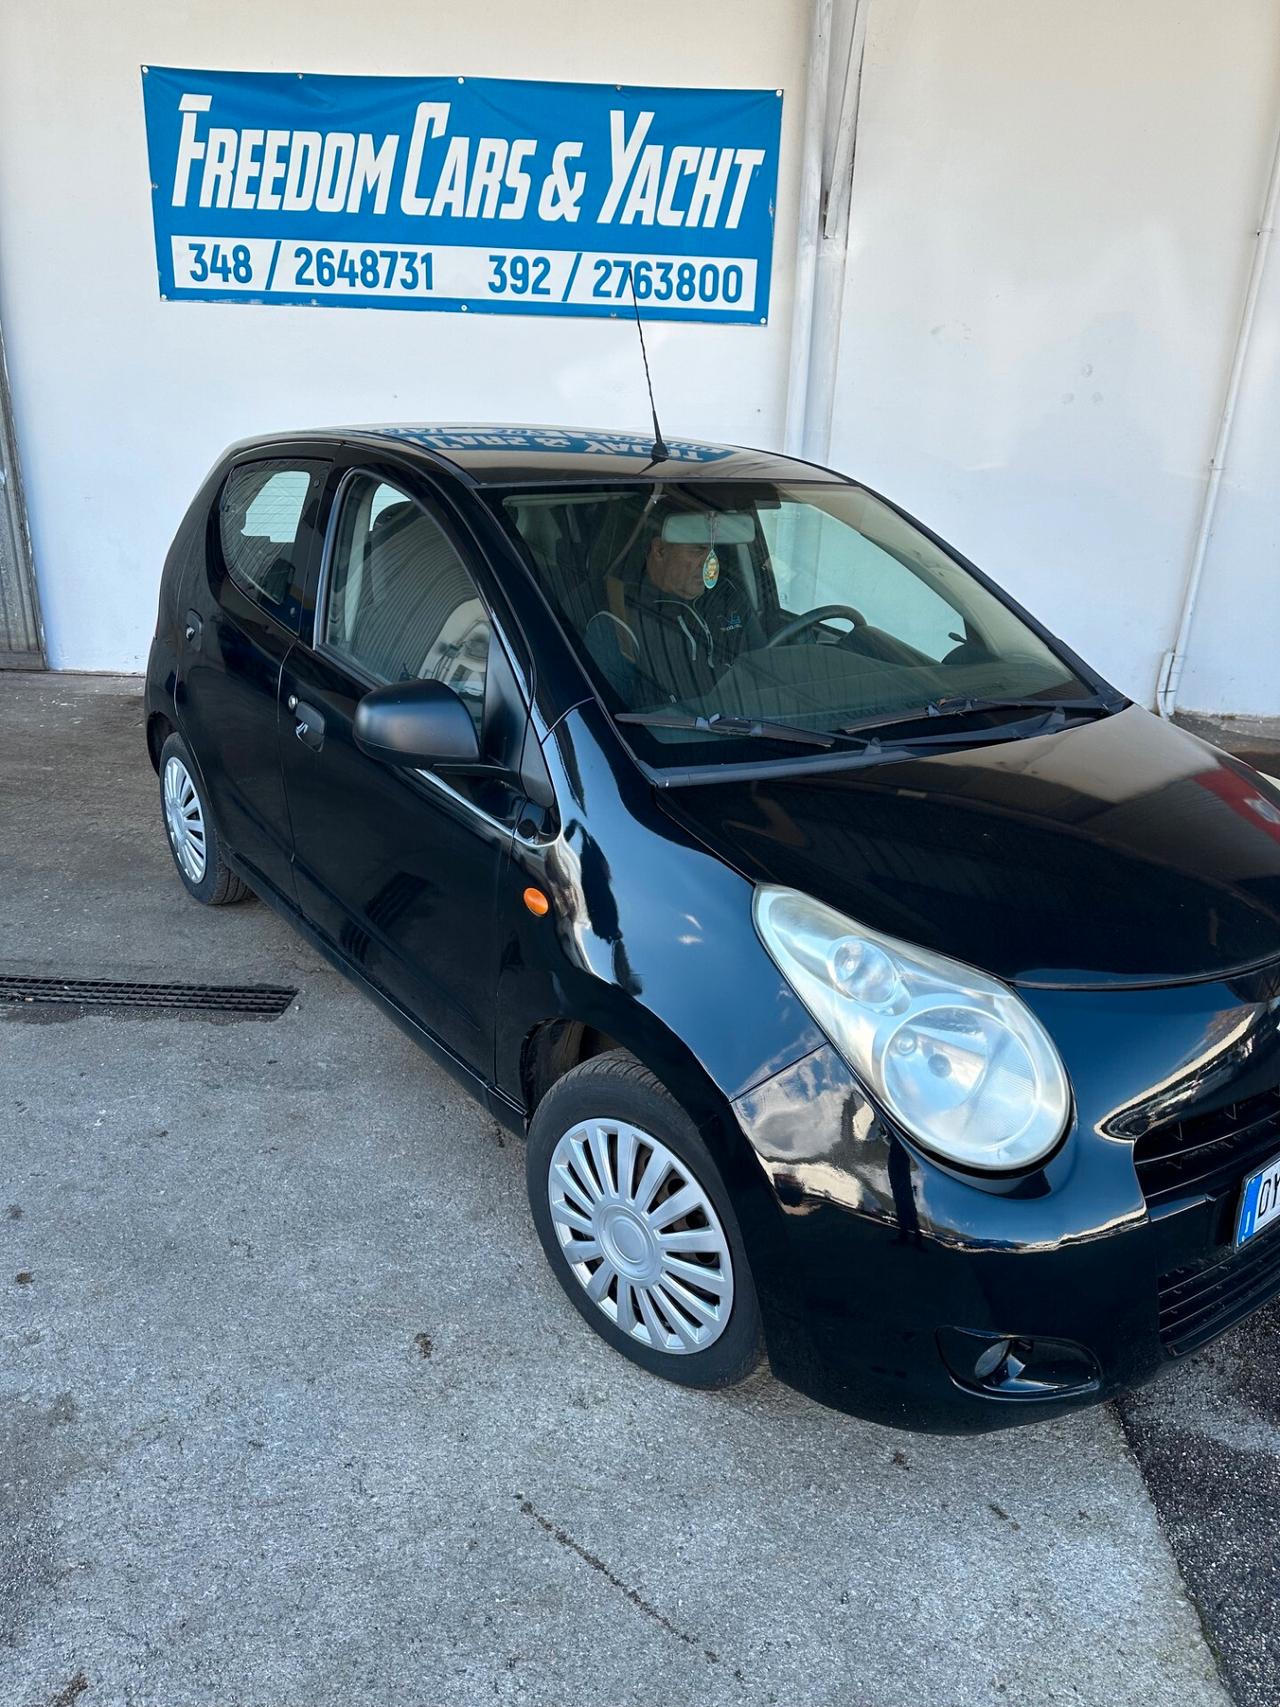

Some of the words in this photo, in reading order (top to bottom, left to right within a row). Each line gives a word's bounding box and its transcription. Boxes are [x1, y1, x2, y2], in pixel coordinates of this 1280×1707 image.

[171, 93, 400, 214] FREEDOM
[400, 102, 537, 220] CARS
[538, 141, 587, 222] &
[596, 110, 766, 229] YACHT
[188, 243, 253, 283] 348
[265, 240, 282, 290] /
[294, 246, 433, 290] 2648731
[488, 255, 551, 295] 392
[562, 252, 583, 302] /
[593, 259, 743, 303] 2763800
